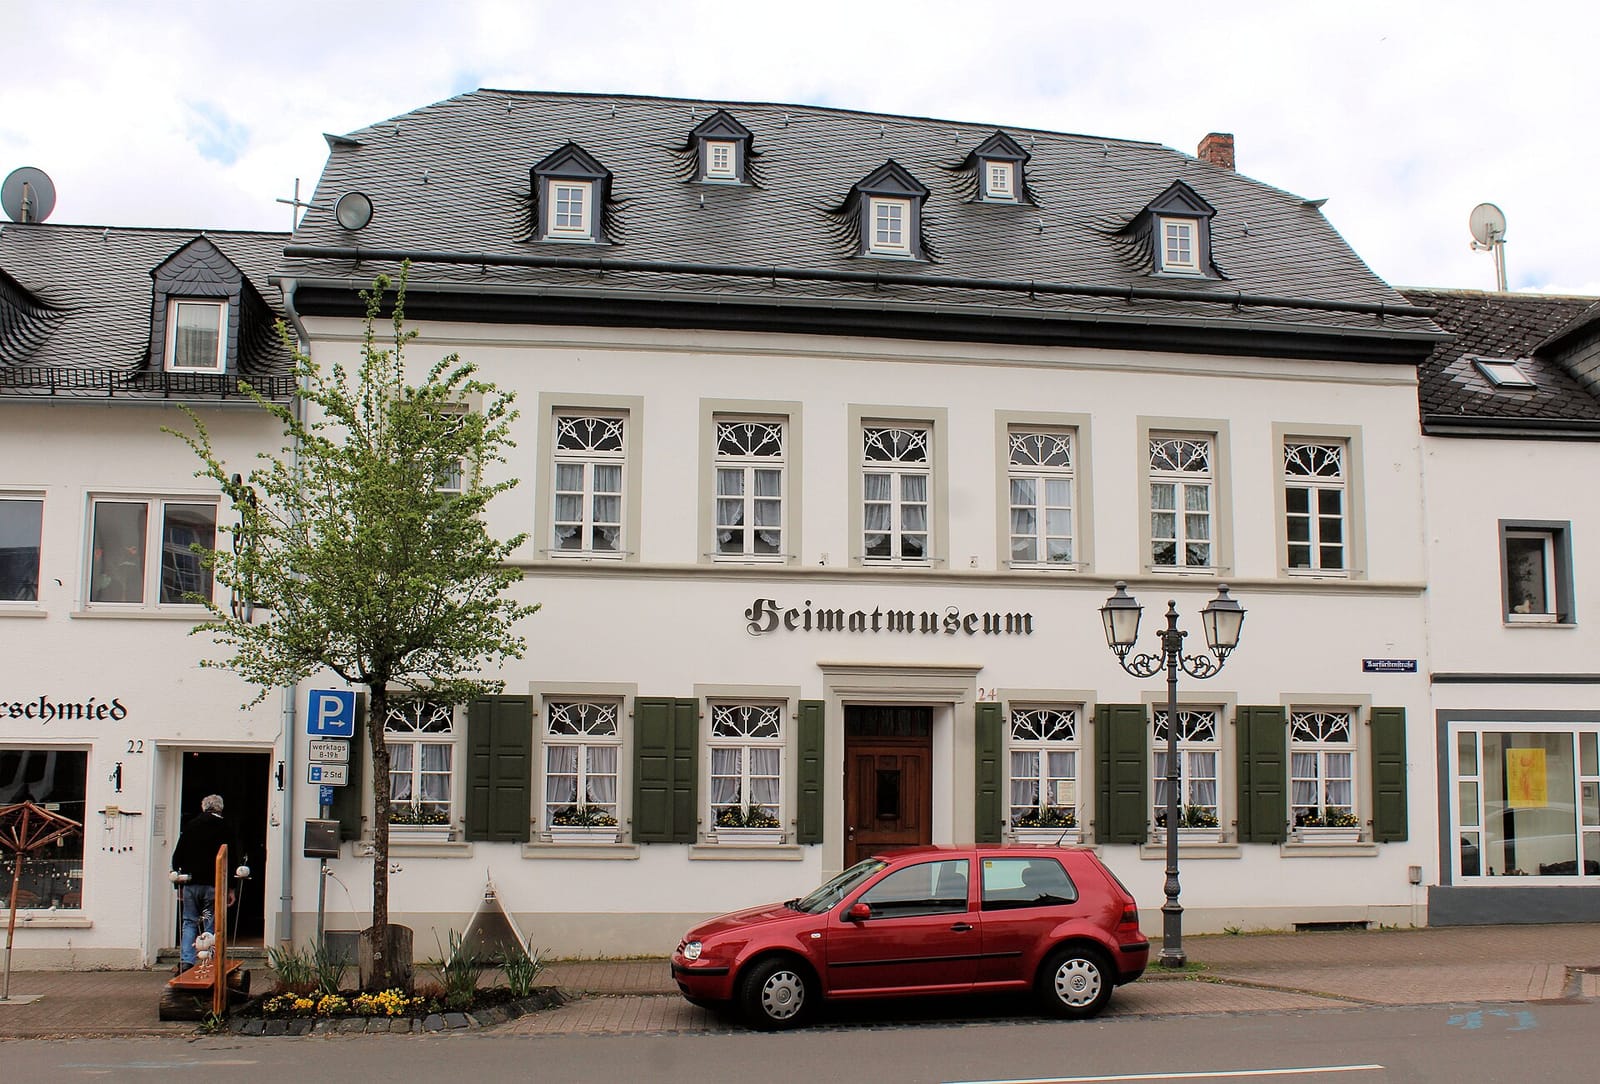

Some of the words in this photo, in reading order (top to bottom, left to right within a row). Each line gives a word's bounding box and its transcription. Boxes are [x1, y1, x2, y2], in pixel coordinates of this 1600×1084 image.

[744, 598, 1034, 636] Heimatmuseum
[978, 687, 997, 701] 24
[317, 695, 344, 730] P
[127, 739, 144, 754] 22
[312, 743, 346, 752] werktags
